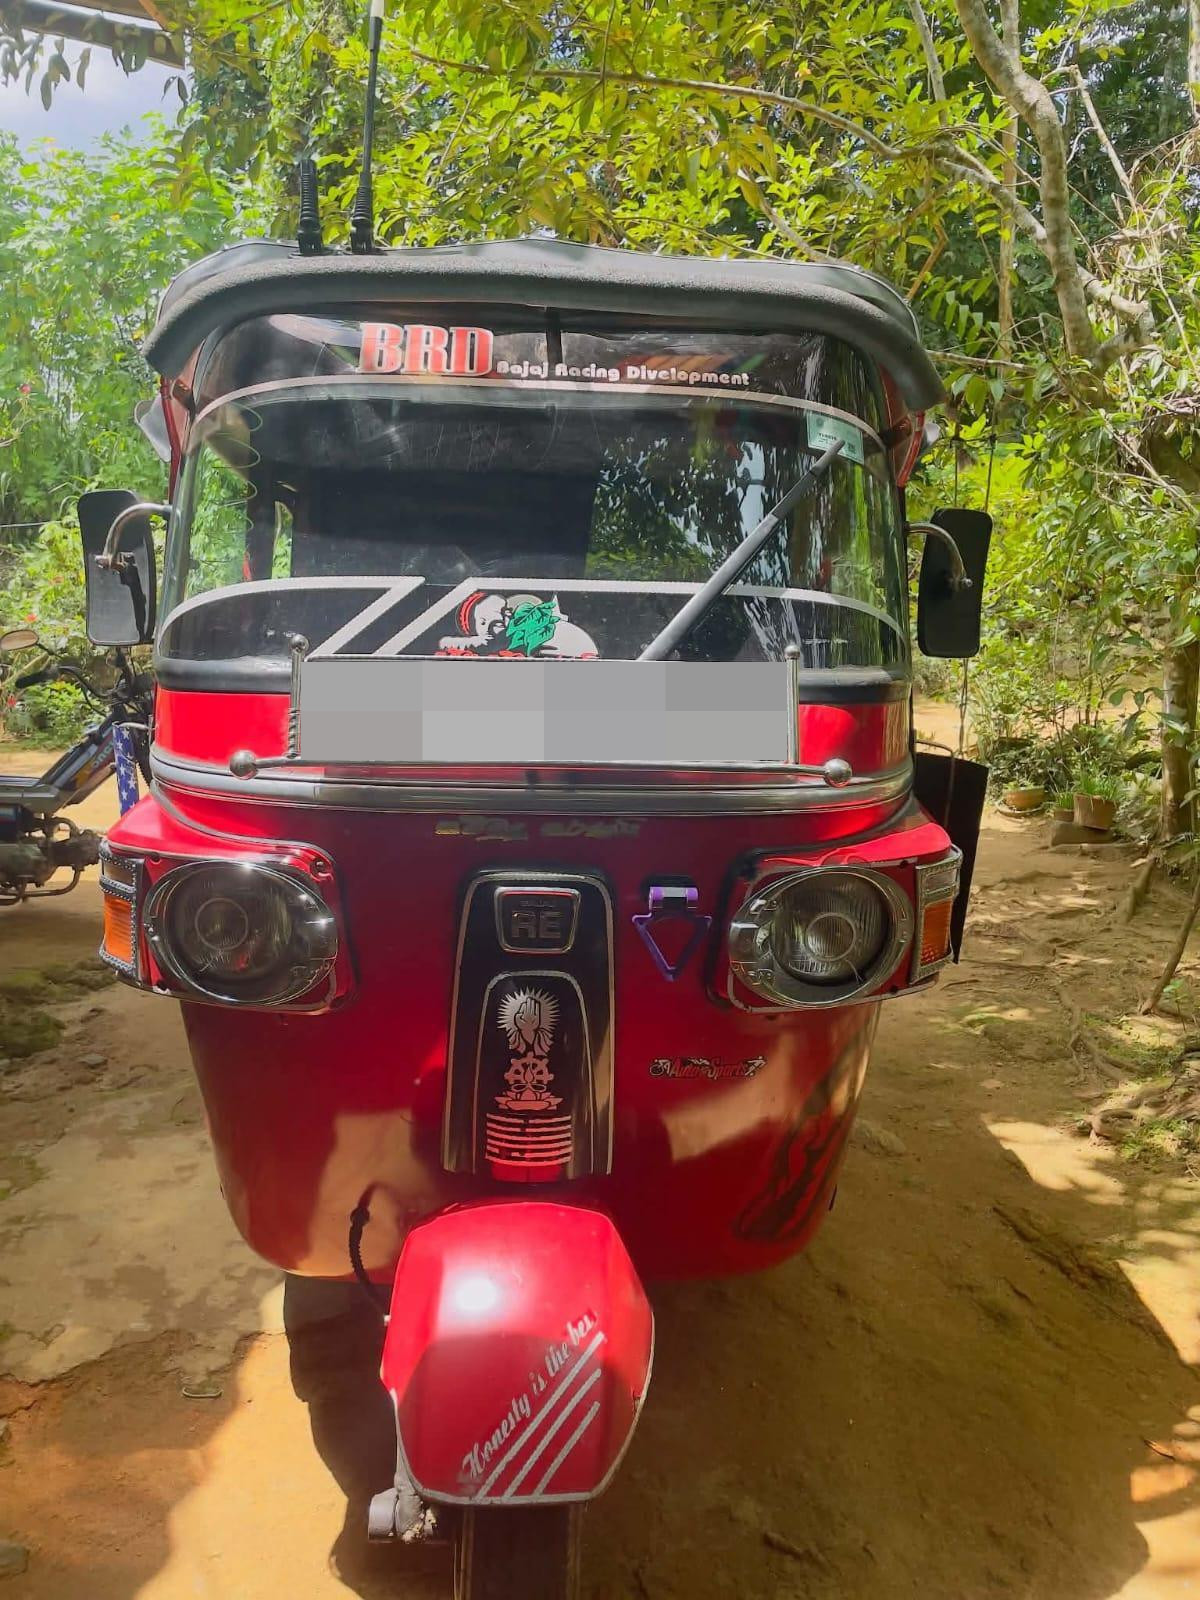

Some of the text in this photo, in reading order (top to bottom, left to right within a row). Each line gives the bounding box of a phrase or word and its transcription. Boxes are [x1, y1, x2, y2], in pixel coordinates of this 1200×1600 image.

[357, 322, 494, 377] BRD
[496, 361, 751, 387] Bajaj Racing Divelopment
[511, 909, 562, 939] RE
[462, 1392, 531, 1478] Honesty
[529, 1372, 548, 1396] is
[544, 1342, 570, 1377] the
